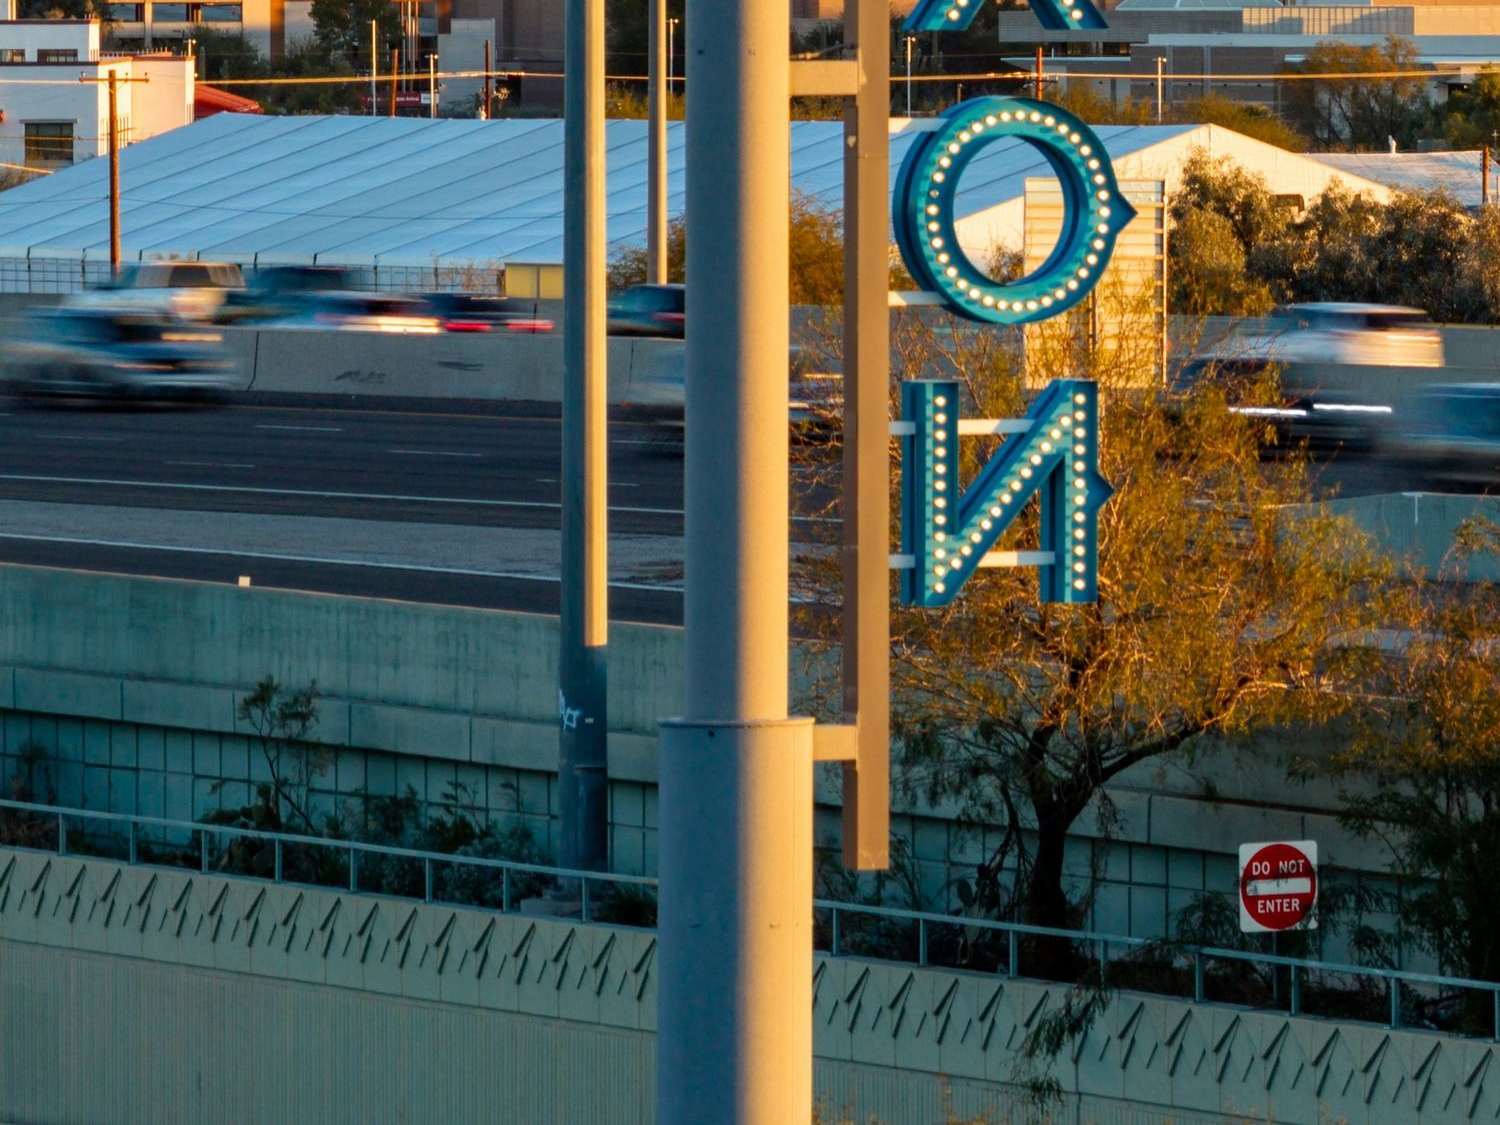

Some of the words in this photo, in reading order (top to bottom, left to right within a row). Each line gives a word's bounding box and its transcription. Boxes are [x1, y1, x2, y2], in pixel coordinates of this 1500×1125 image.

[1252, 861, 1271, 876] DO
[1279, 859, 1305, 874] NOT
[1257, 898, 1301, 914] ENTER
